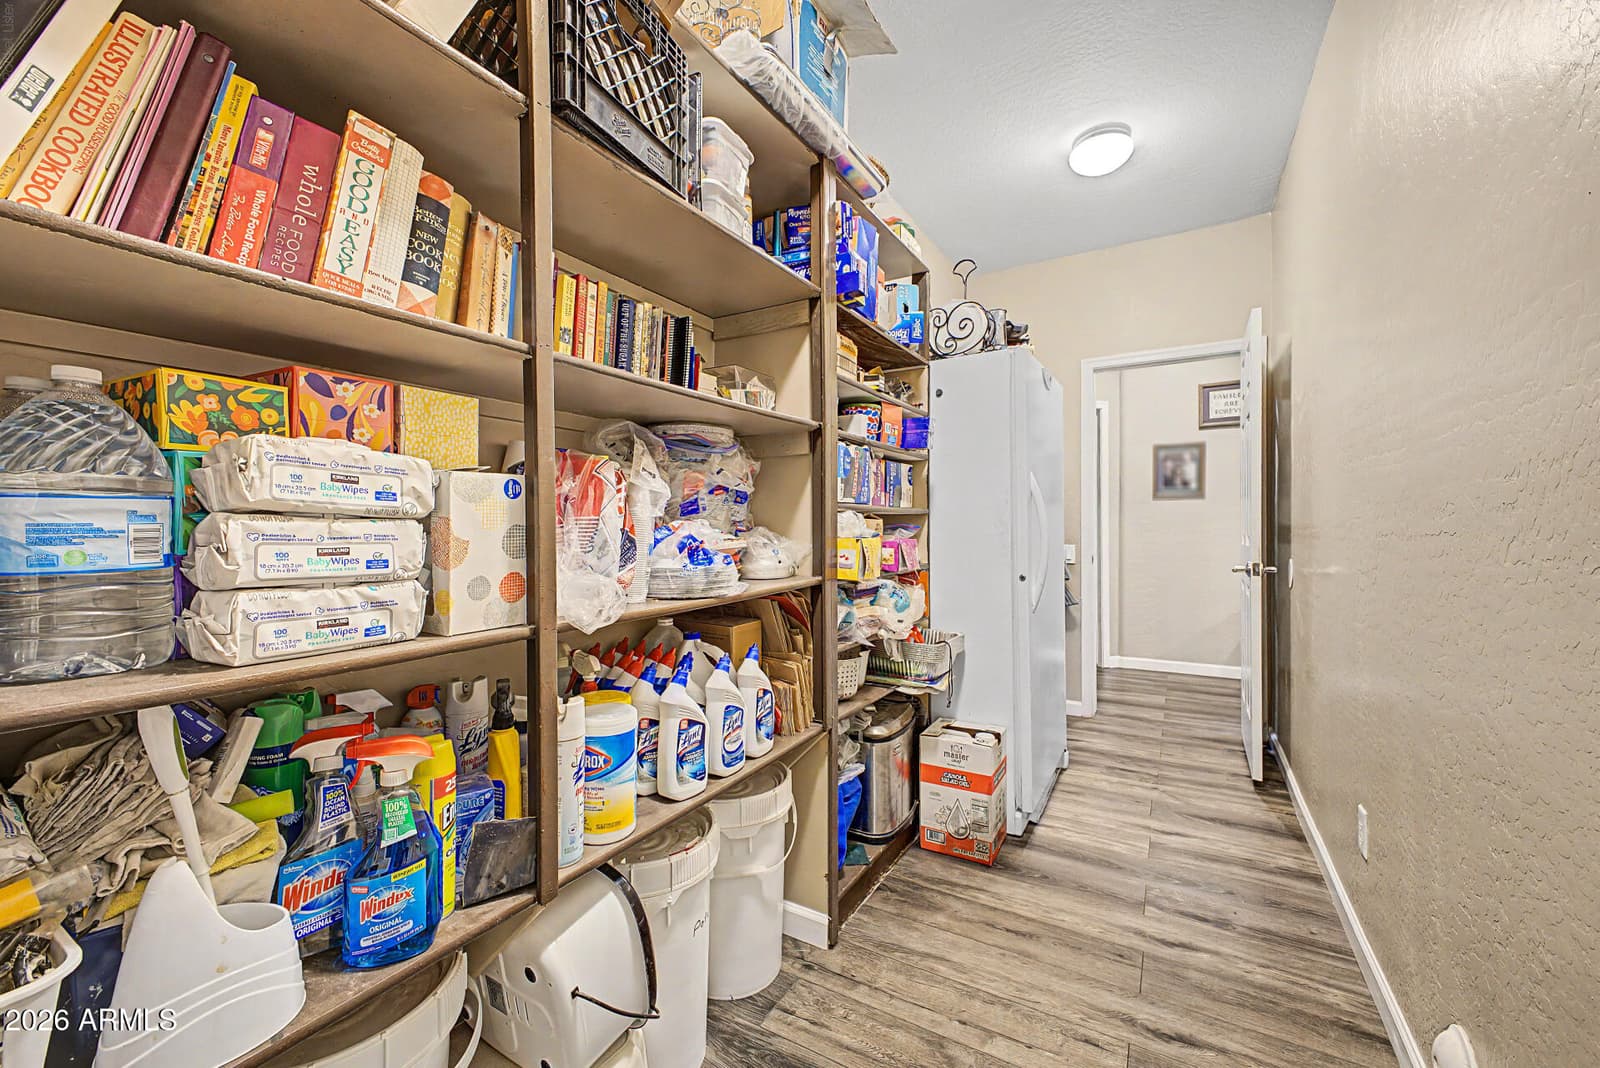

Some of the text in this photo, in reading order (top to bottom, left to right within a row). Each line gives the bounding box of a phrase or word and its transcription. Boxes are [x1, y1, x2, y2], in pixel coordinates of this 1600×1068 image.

[17, 66, 53, 103] weber
[69, 19, 146, 127] ILLUSTRATED
[101, 101, 120, 125] GOOD
[72, 120, 109, 176] HOUSEKEEPING
[360, 138, 380, 154] Betty
[347, 157, 375, 214] GOOD
[250, 189, 268, 218] Whole
[244, 217, 261, 242] Food
[416, 229, 439, 244] NEW
[270, 226, 285, 266] RECIPES
[281, 229, 303, 274] FOOD
[334, 219, 361, 275] EASY
[408, 238, 442, 262] COOK
[407, 250, 441, 273] BOOK
[621, 303, 630, 318] OUT
[273, 628, 287, 636] 100
[267, 752, 284, 761] FOAM
[585, 755, 605, 768] ROX
[325, 796, 346, 806] OCEAN
[326, 790, 345, 800] 100%
[385, 802, 408, 812] 100%
[323, 807, 348, 819] PLASTIC
[282, 869, 347, 913] Winde
[361, 887, 415, 924] Windex
[296, 914, 333, 938] ORIGINAL
[369, 917, 403, 934] ORIGINAL
